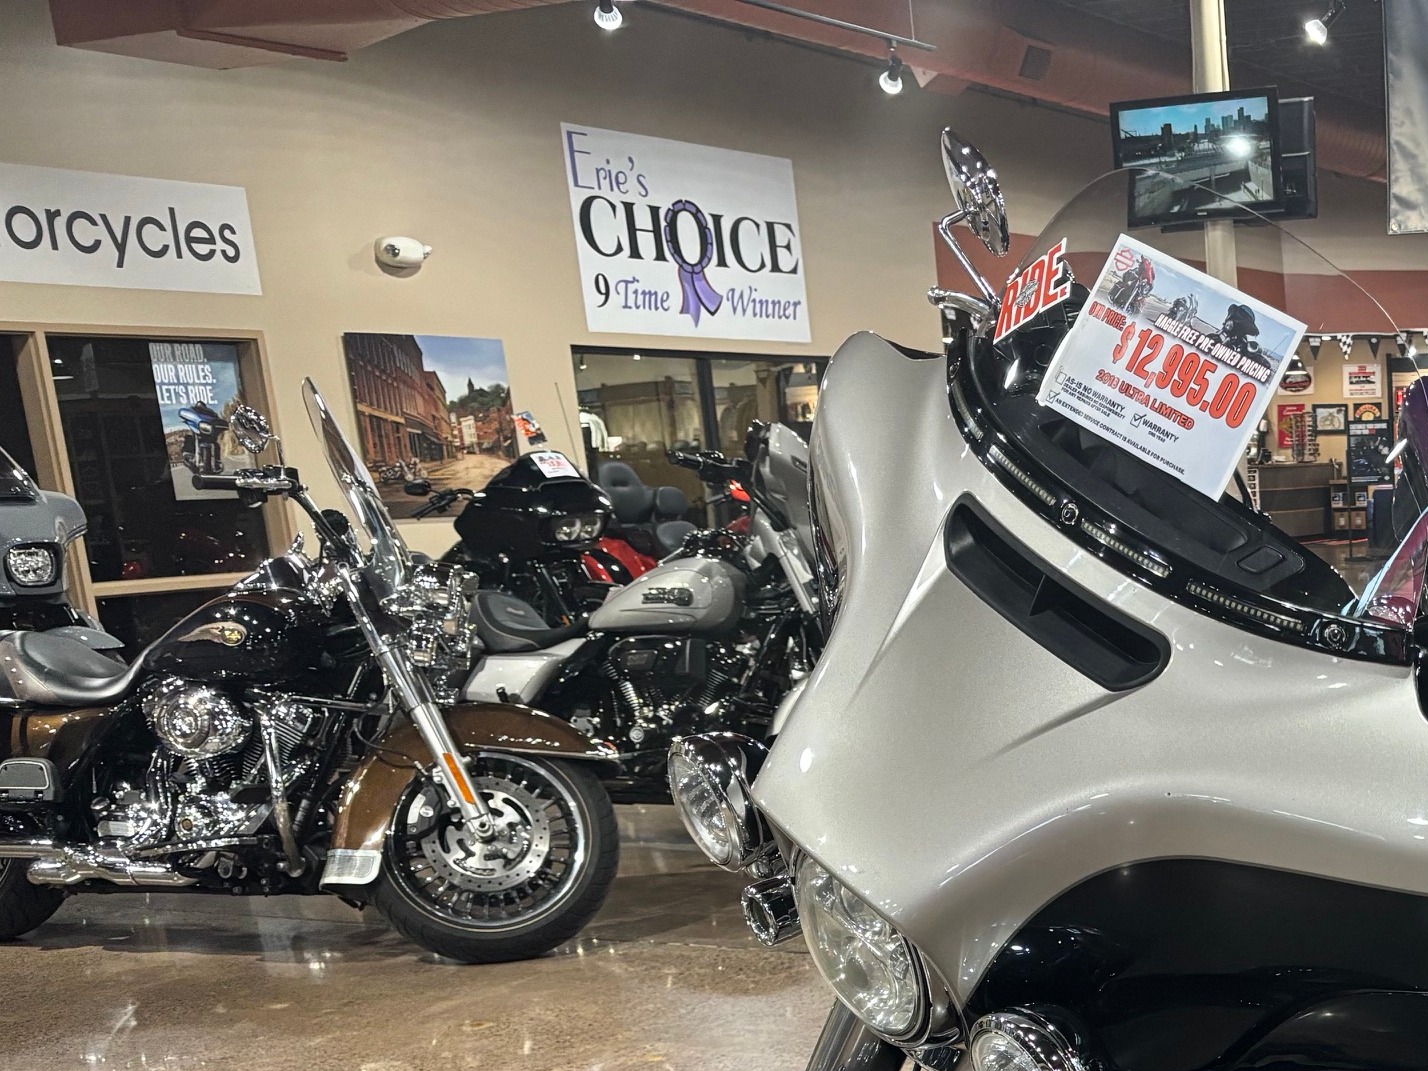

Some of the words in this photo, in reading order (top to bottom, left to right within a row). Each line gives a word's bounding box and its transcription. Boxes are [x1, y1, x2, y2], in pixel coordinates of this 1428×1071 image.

[566, 130, 648, 197] Erie's
[5, 205, 240, 268] orcycles
[580, 195, 799, 275] CHOICE
[594, 273, 610, 308] 9
[615, 276, 670, 311] Time
[727, 286, 801, 320] Winner
[149, 343, 172, 361] OUR
[174, 343, 207, 362] ROAD.
[1154, 312, 1183, 336] HAGGLE
[1177, 324, 1199, 345] FREE
[1194, 333, 1240, 367] PRE-OWNED
[1236, 355, 1270, 383] PRICING
[153, 364, 177, 383] OUR
[177, 364, 216, 383] RULES.
[156, 385, 187, 404] LET'S
[188, 386, 218, 404] RIDE.
[1066, 375, 1083, 389] AS-IS
[1091, 390, 1125, 413] WARRANTY
[1117, 380, 1152, 407] ULTRA
[1149, 397, 1196, 431] LIMITED
[1099, 423, 1122, 439] CONTRACT
[1126, 438, 1150, 455] AVAILABLE
[1141, 417, 1178, 443] WARRANTY
